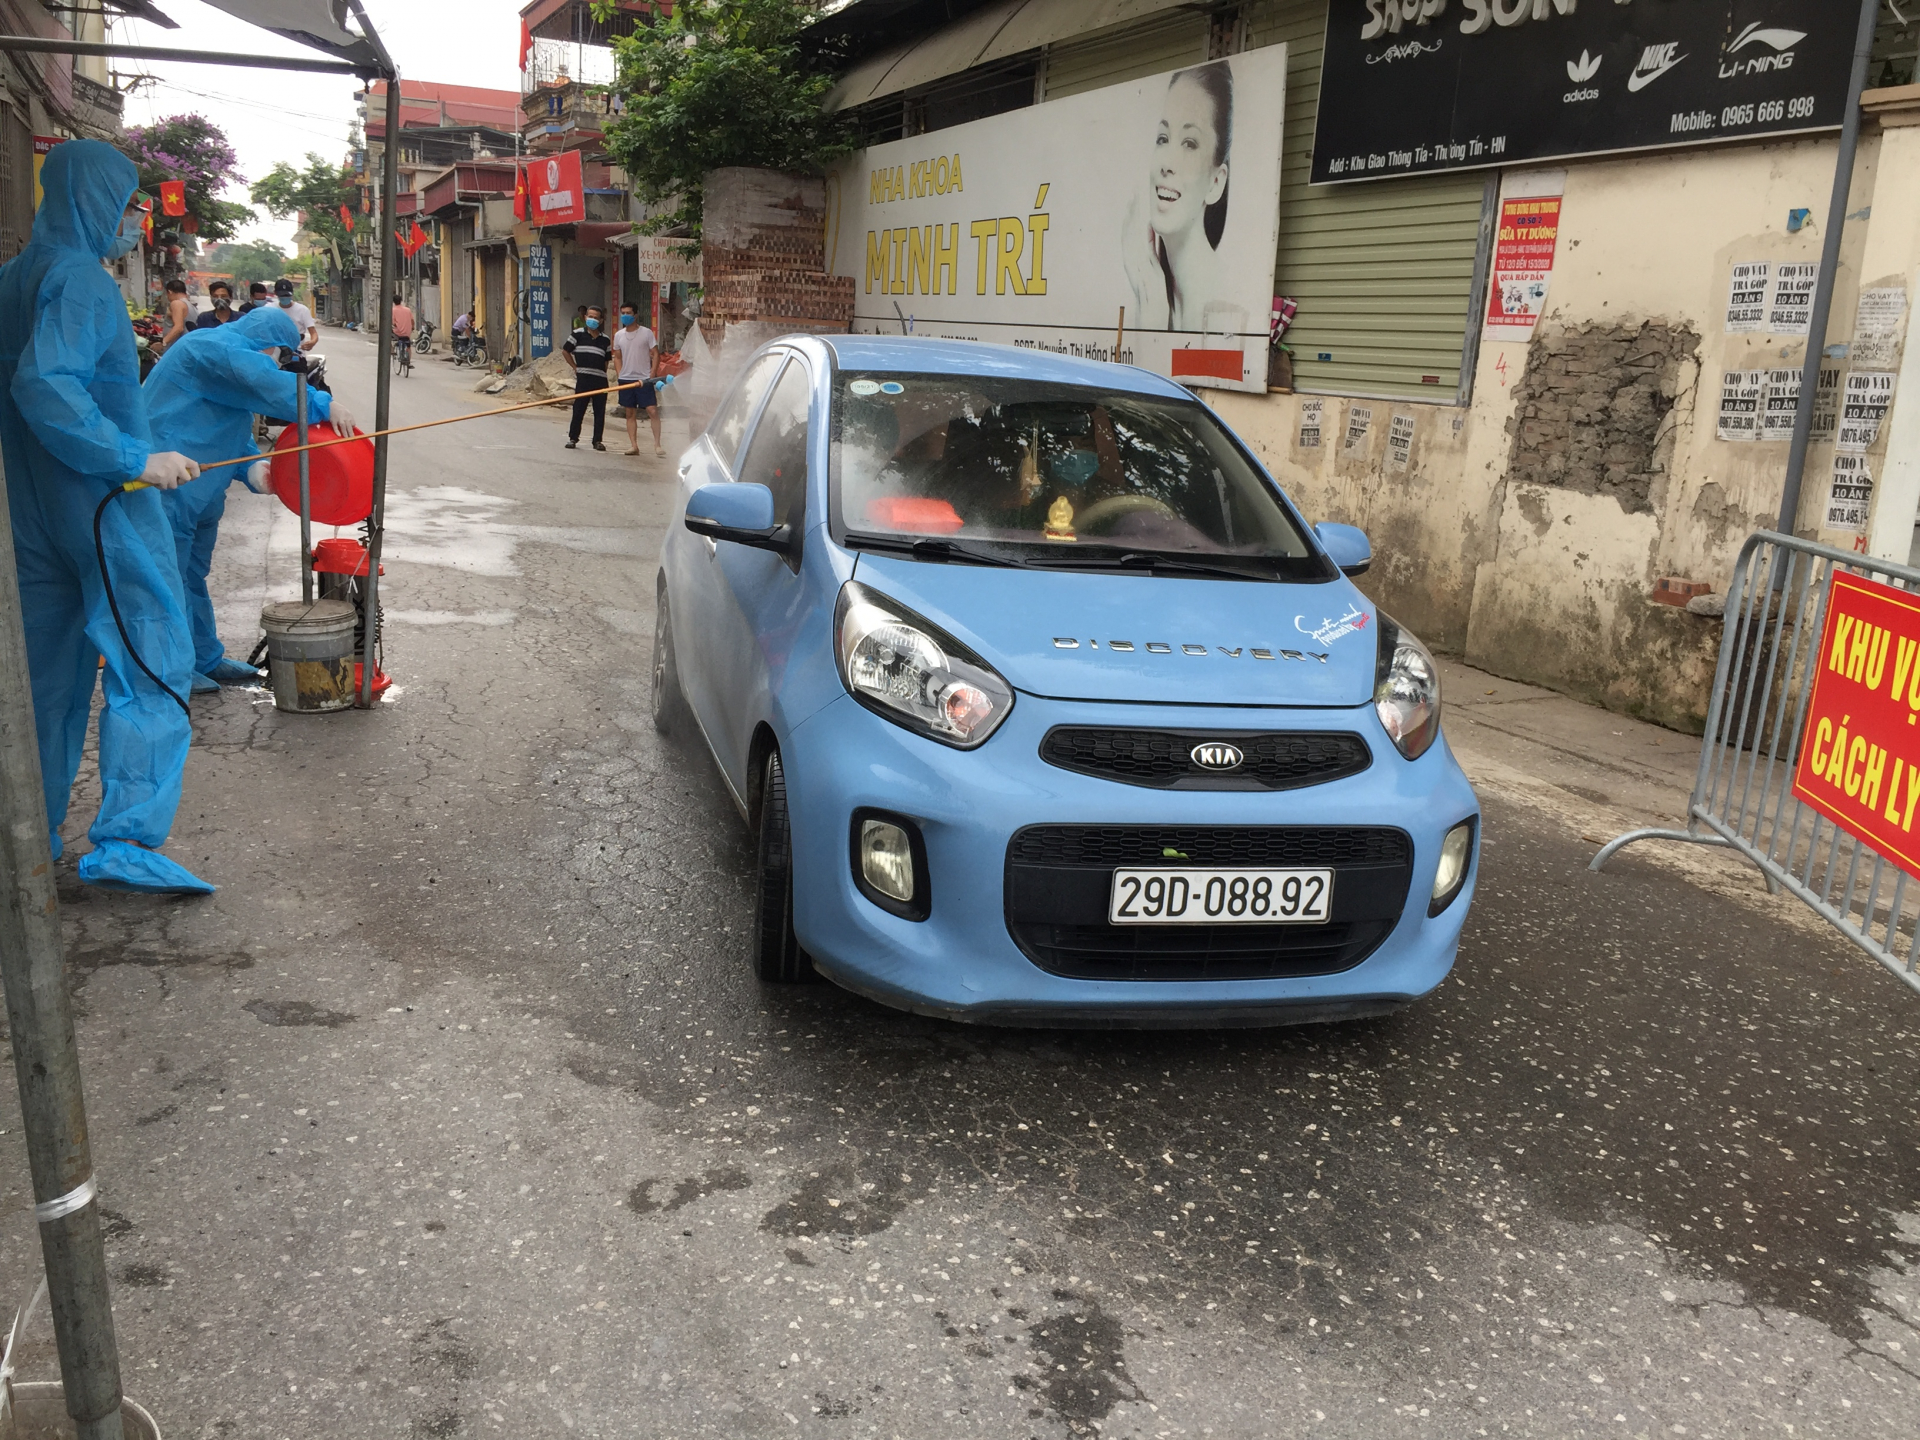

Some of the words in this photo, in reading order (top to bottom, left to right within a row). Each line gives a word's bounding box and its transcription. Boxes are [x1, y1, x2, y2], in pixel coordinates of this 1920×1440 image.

[1637, 41, 1678, 71] NIKE
[1718, 52, 1795, 79] LI-NING
[1563, 88, 1599, 103] adidas
[1670, 112, 1716, 133] Mobile:
[1721, 103, 1754, 127] 0965
[1757, 99, 1784, 122] 666
[1787, 96, 1814, 119] 998
[1350, 155, 1366, 171] Khu
[1368, 153, 1386, 169] Giao
[1388, 150, 1412, 167] Thông
[1491, 136, 1506, 154] HN
[870, 165, 905, 204] NHA
[908, 153, 964, 200] KHOA
[865, 223, 959, 295] MINH
[970, 182, 1050, 295] TRÍ
[1500, 226, 1514, 240] SỮA
[1517, 228, 1528, 240] VY
[533, 257, 545, 267] XE
[1515, 271, 1528, 280] HẤP
[1752, 265, 1768, 276] VAY
[1798, 266, 1816, 277] VAY
[1750, 276, 1767, 289] GÓP
[1796, 278, 1814, 291] GÓP
[533, 288, 549, 302] SỬA
[1733, 295, 1742, 303] 10
[1743, 293, 1756, 303] ĂN
[1757, 294, 1762, 302] 9
[1777, 296, 1787, 304] 10
[1788, 293, 1800, 304] ĂN
[1801, 296, 1807, 304] 9
[534, 303, 545, 315] XE
[533, 320, 549, 331] ĐẠP
[532, 334, 549, 349] ĐIỆN
[1744, 373, 1759, 385] AY
[1791, 371, 1802, 382] VA
[1820, 370, 1840, 388] VAY
[1873, 376, 1891, 389] VAY
[1741, 387, 1758, 398] GÓP
[1788, 383, 1800, 396] GÓ
[1770, 401, 1779, 409] 10
[1782, 398, 1795, 409] ĂN
[1870, 392, 1890, 404] GÓP
[1734, 400, 1747, 410] ĂN
[1848, 409, 1859, 417] 10
[1861, 405, 1876, 418] ĂN
[1879, 410, 1885, 418] 9
[1841, 428, 1877, 443] 0976.495.1
[1835, 489, 1847, 497] 10
[1848, 487, 1863, 498] ĂN
[353, 597, 366, 656] INOX
[1052, 637, 1329, 664] DISCOVERY
[1829, 612, 1891, 690] KHU
[1200, 747, 1237, 764] KIA
[1811, 714, 1887, 811] CÁCH
[1884, 757, 1920, 833] LY
[1117, 875, 1325, 917] 29D-088.92
